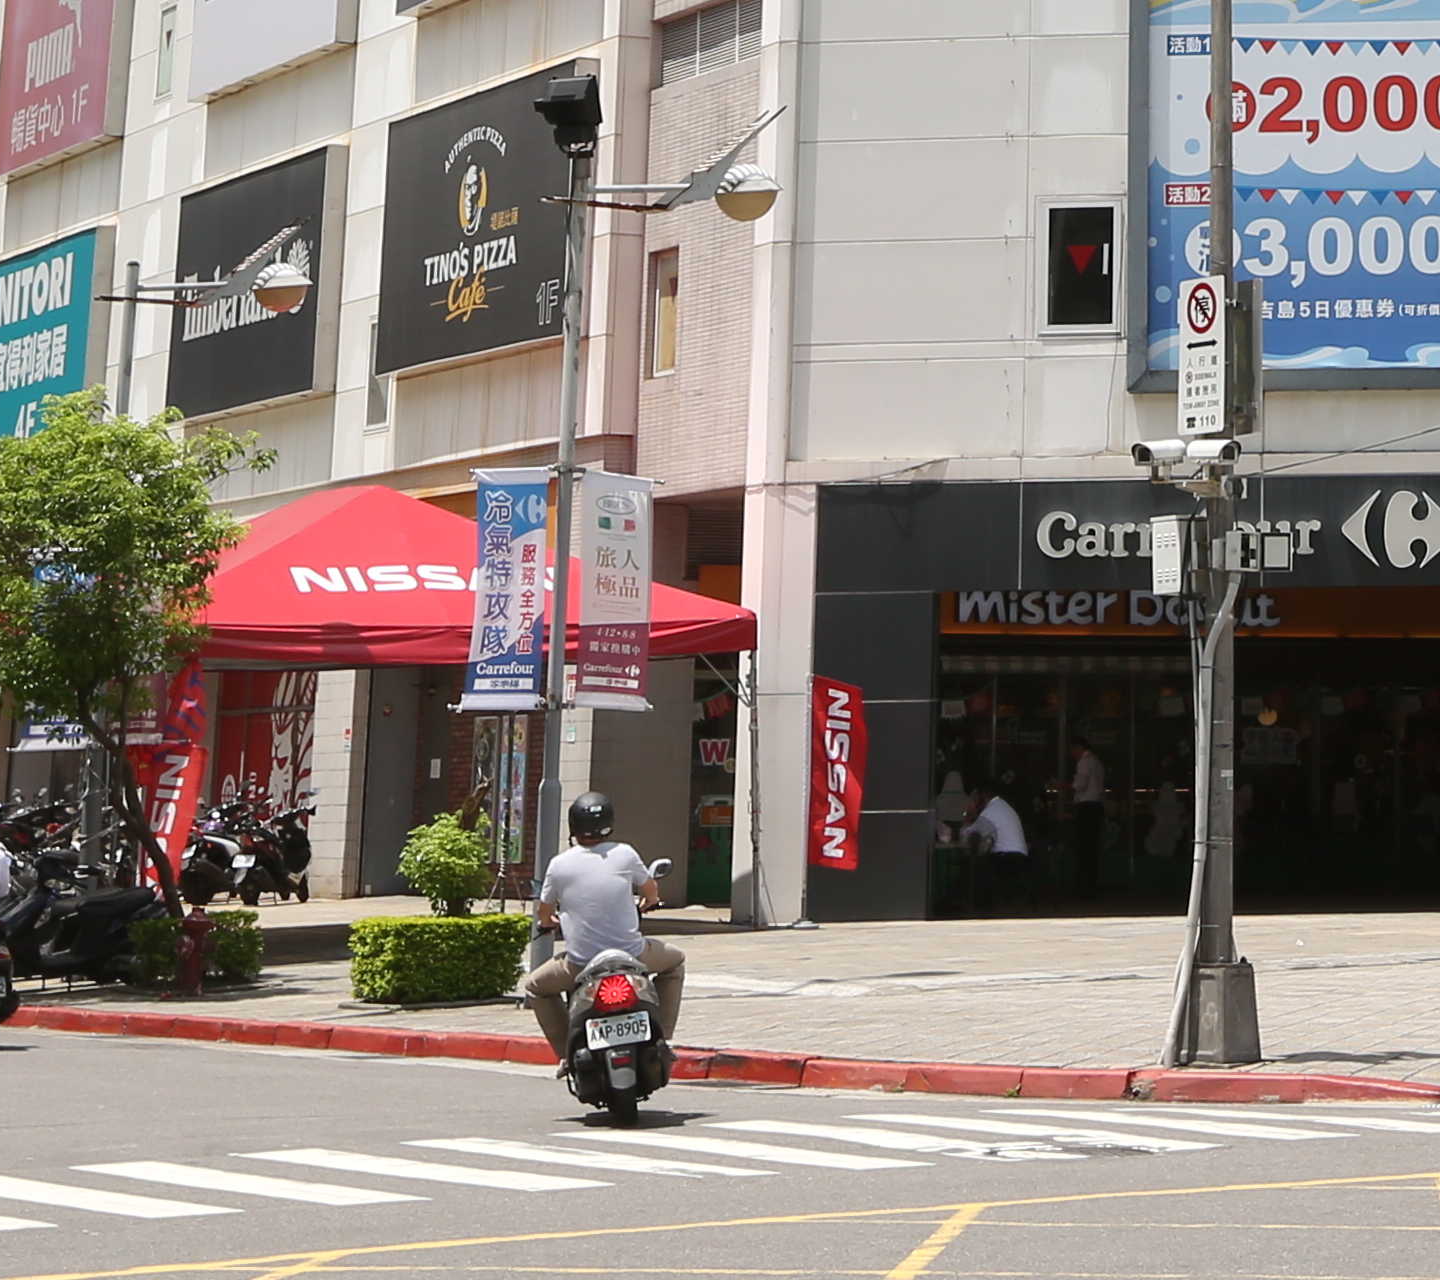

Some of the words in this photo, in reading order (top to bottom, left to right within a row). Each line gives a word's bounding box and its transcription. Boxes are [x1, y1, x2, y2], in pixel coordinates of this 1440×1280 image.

[24, 24, 75, 92] PUMA
[71, 83, 90, 125] 1F
[444, 125, 486, 174] AUTHENTIC
[486, 126, 507, 157] PIZZA
[473, 235, 517, 275] PIZZA
[535, 278, 560, 326] 1F
[1200, 415, 1216, 426] 110
[480, 490, 513, 655] 冷氣特攻隊
[595, 545, 640, 571] 旅人
[516, 544, 537, 654] 服務全方位
[595, 572, 640, 599] 極品
[955, 590, 1118, 626] Mister
[476, 662, 534, 674] Carrefour
[583, 663, 623, 674] Carrefour
[821, 688, 853, 860] NISSAN
[591, 1020, 647, 1042] AAP-8905
